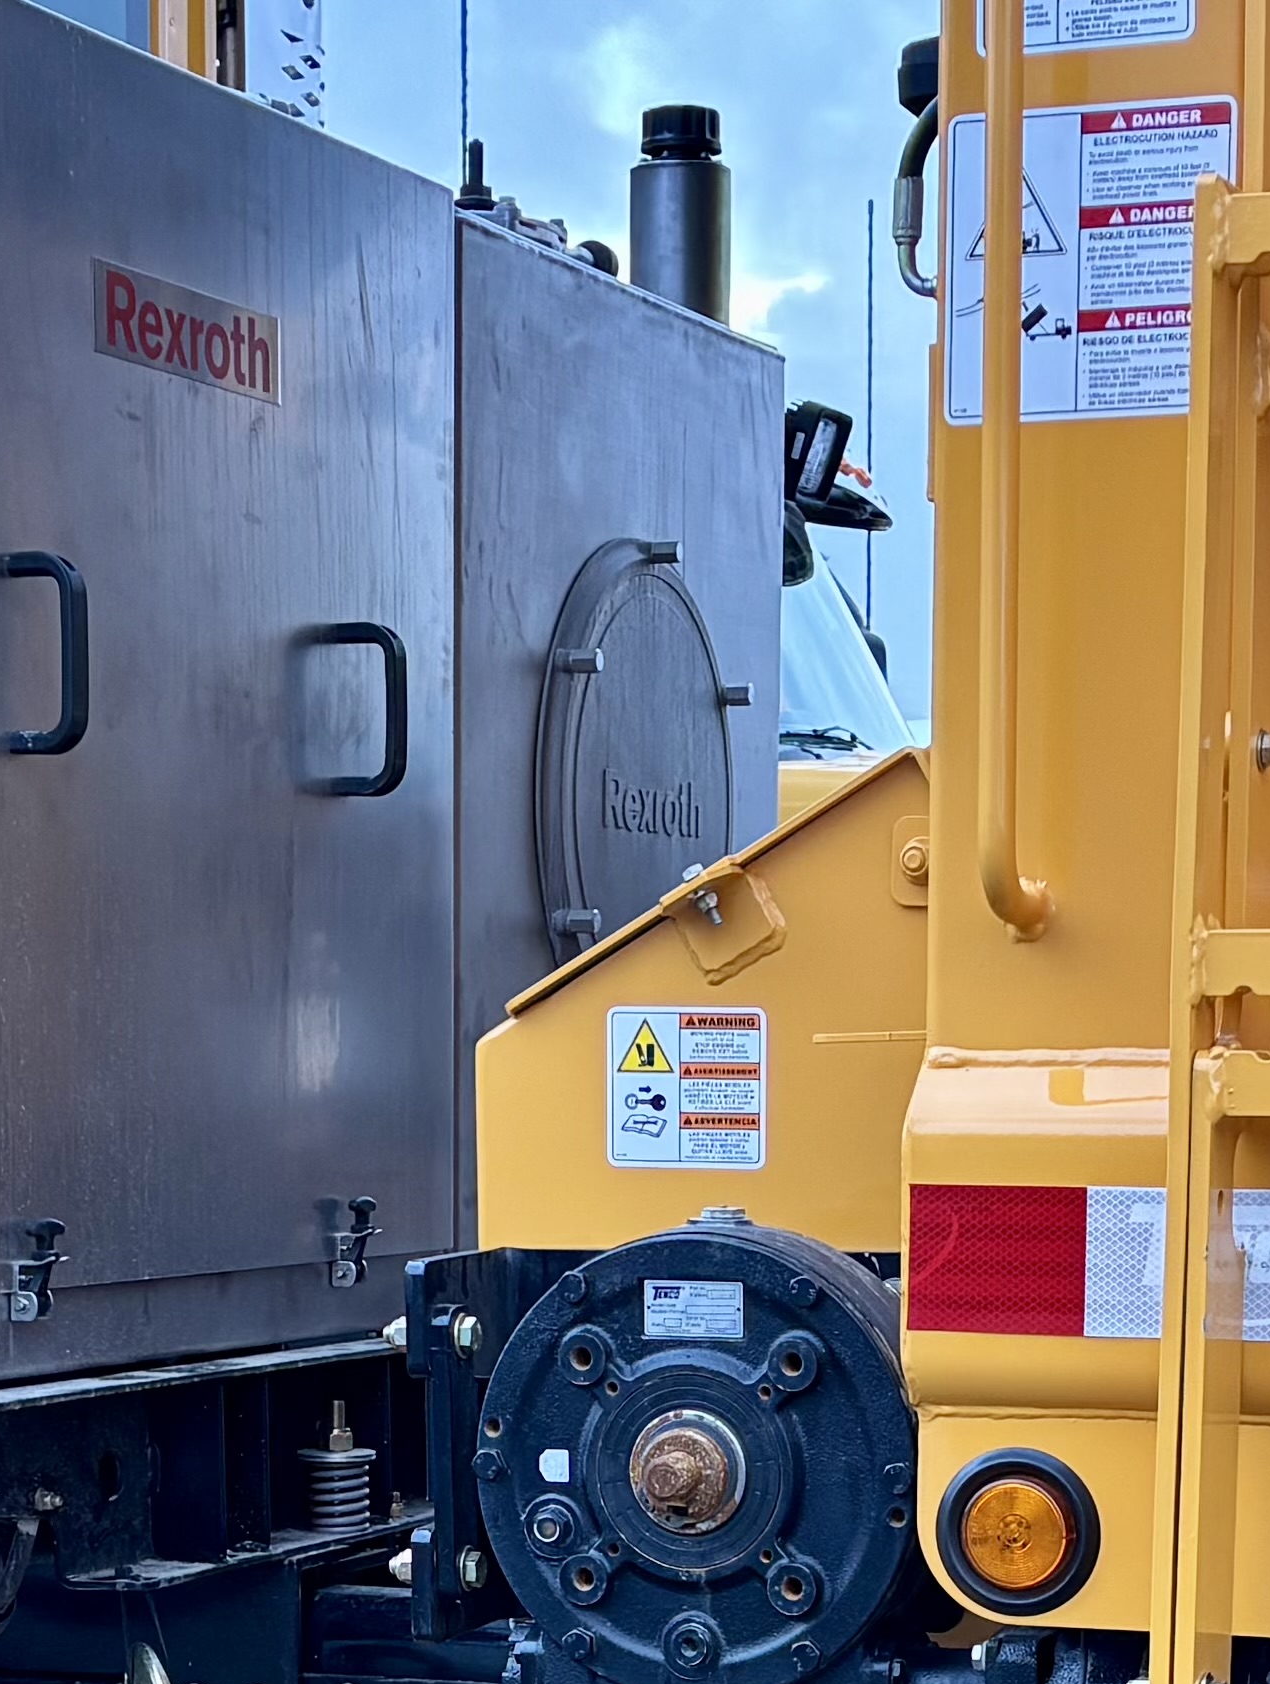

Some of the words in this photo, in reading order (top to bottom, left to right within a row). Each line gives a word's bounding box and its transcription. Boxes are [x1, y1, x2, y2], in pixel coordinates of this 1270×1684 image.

[1131, 109, 1202, 127] DANGER
[1093, 132, 1175, 146] ELECTROCUTION
[1177, 129, 1218, 141] HAZARD
[106, 269, 271, 393] Rexroth
[1121, 335, 1135, 345] DE
[602, 768, 701, 840] Rexroth
[697, 1017, 756, 1028] WARNING
